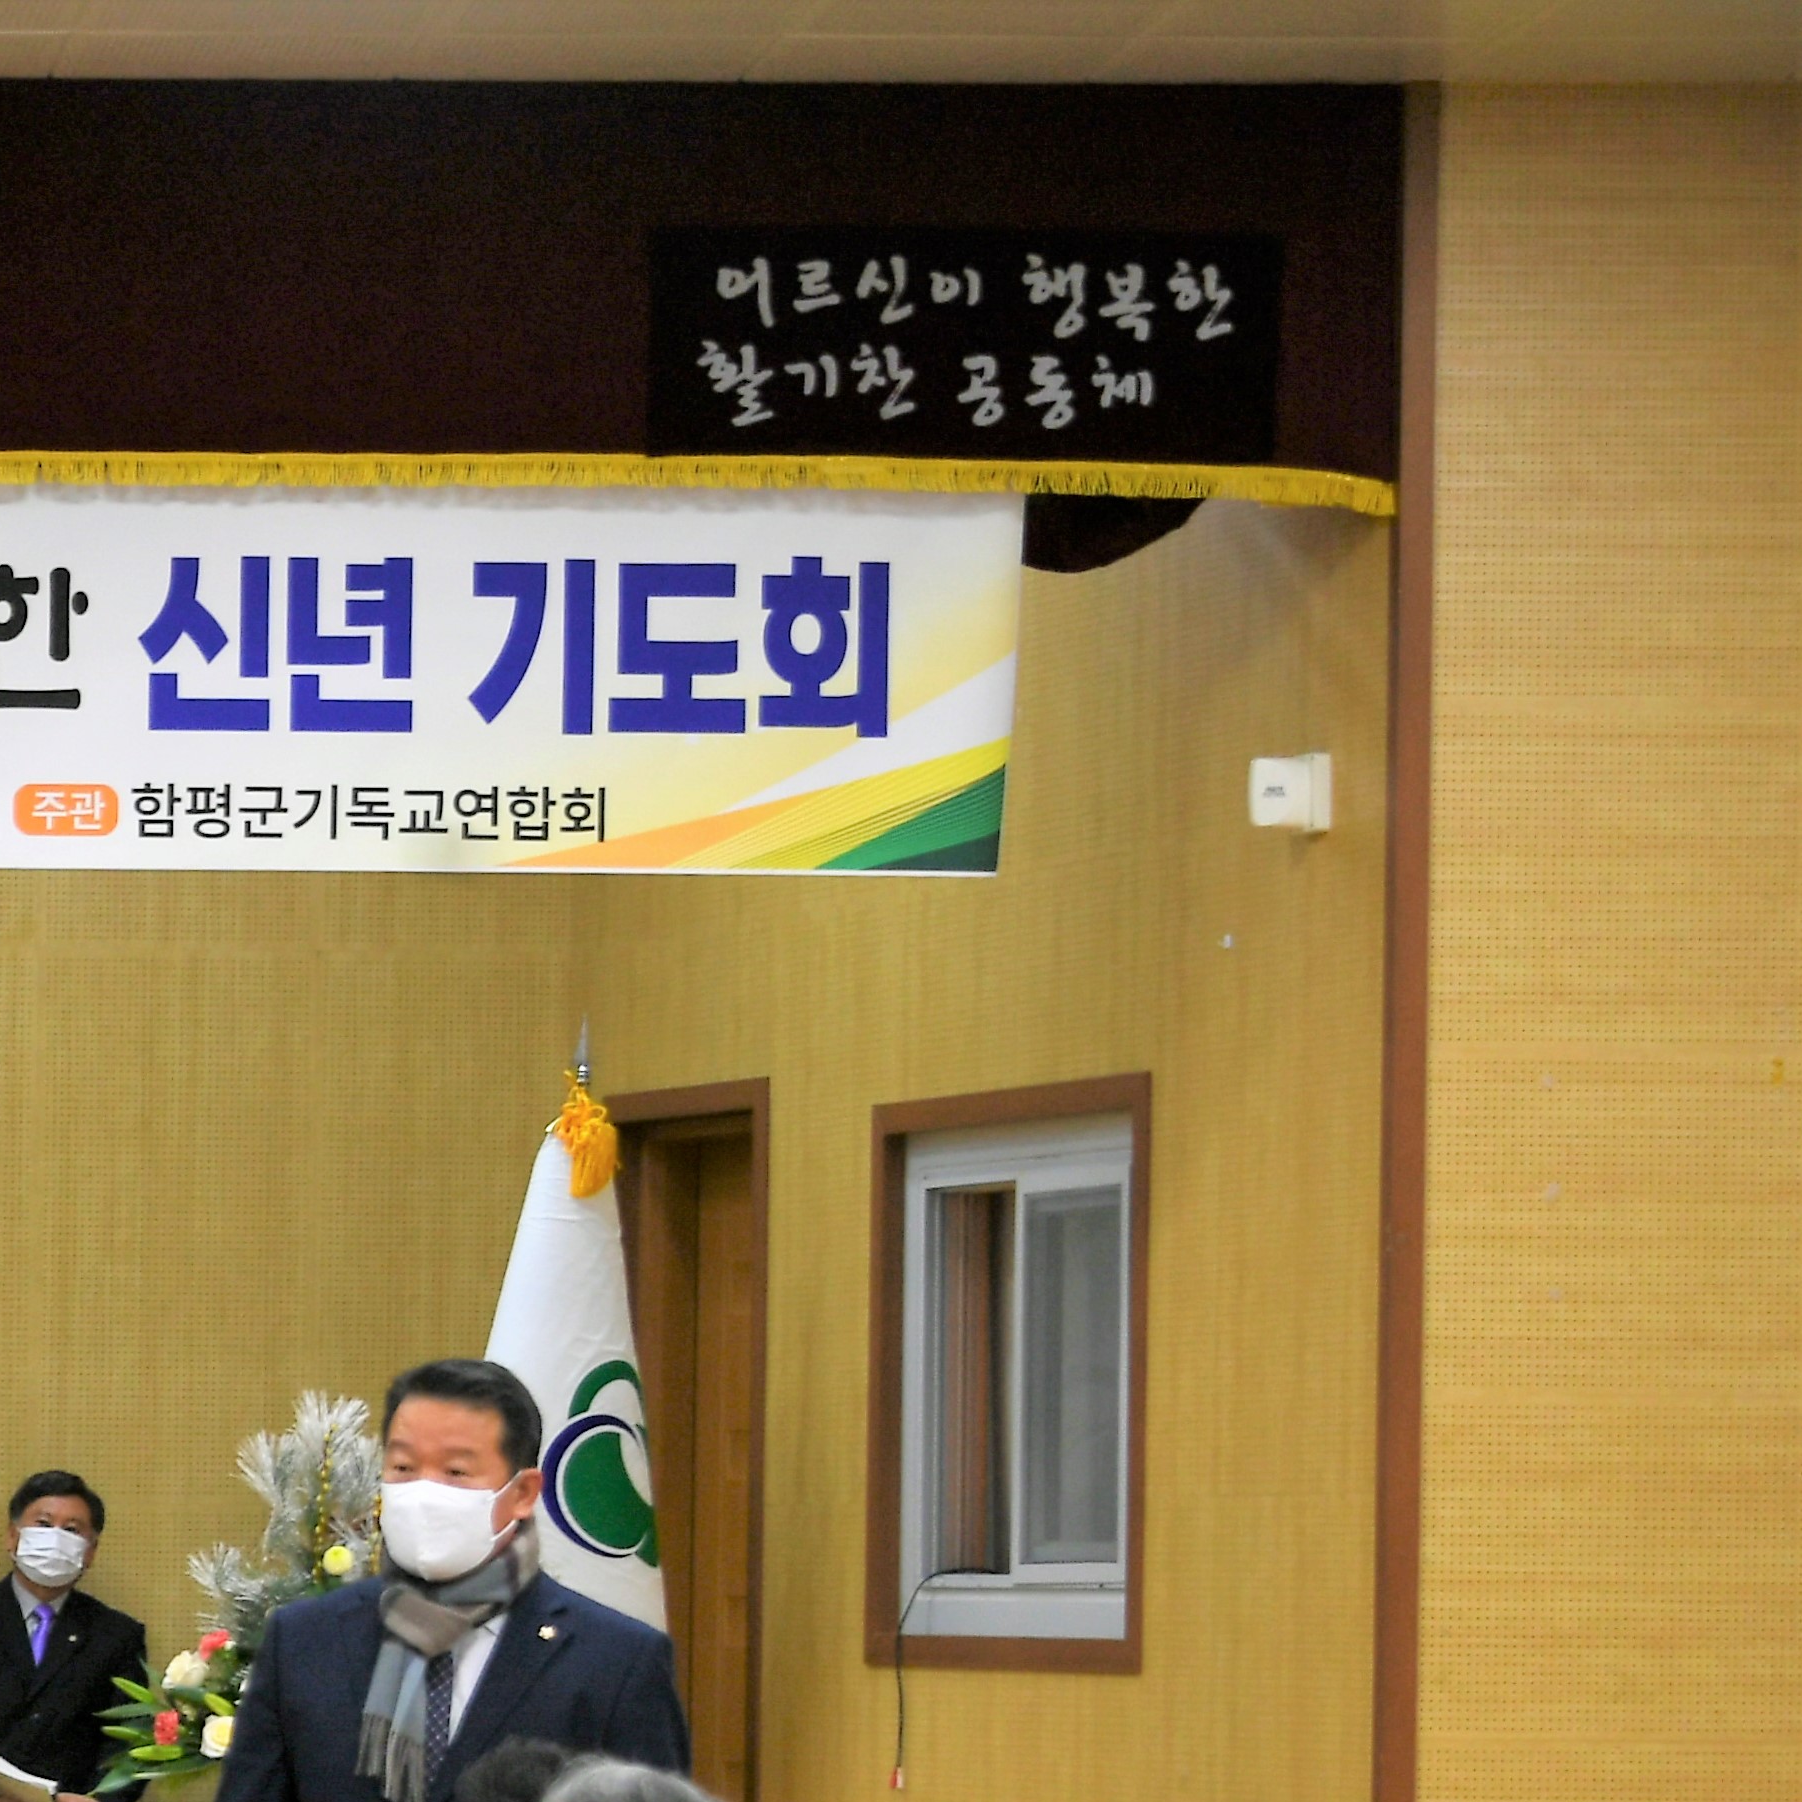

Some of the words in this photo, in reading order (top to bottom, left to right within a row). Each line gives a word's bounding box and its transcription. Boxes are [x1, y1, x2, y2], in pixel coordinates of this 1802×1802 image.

[716, 256, 982, 327] 어르신이
[1023, 256, 1233, 341] 행복한
[957, 354, 1154, 429] 공동체
[139, 556, 413, 732] 신년
[469, 557, 889, 737] 기도회
[31, 791, 105, 829] 주관
[131, 783, 606, 842] 함평군기독교연합회
